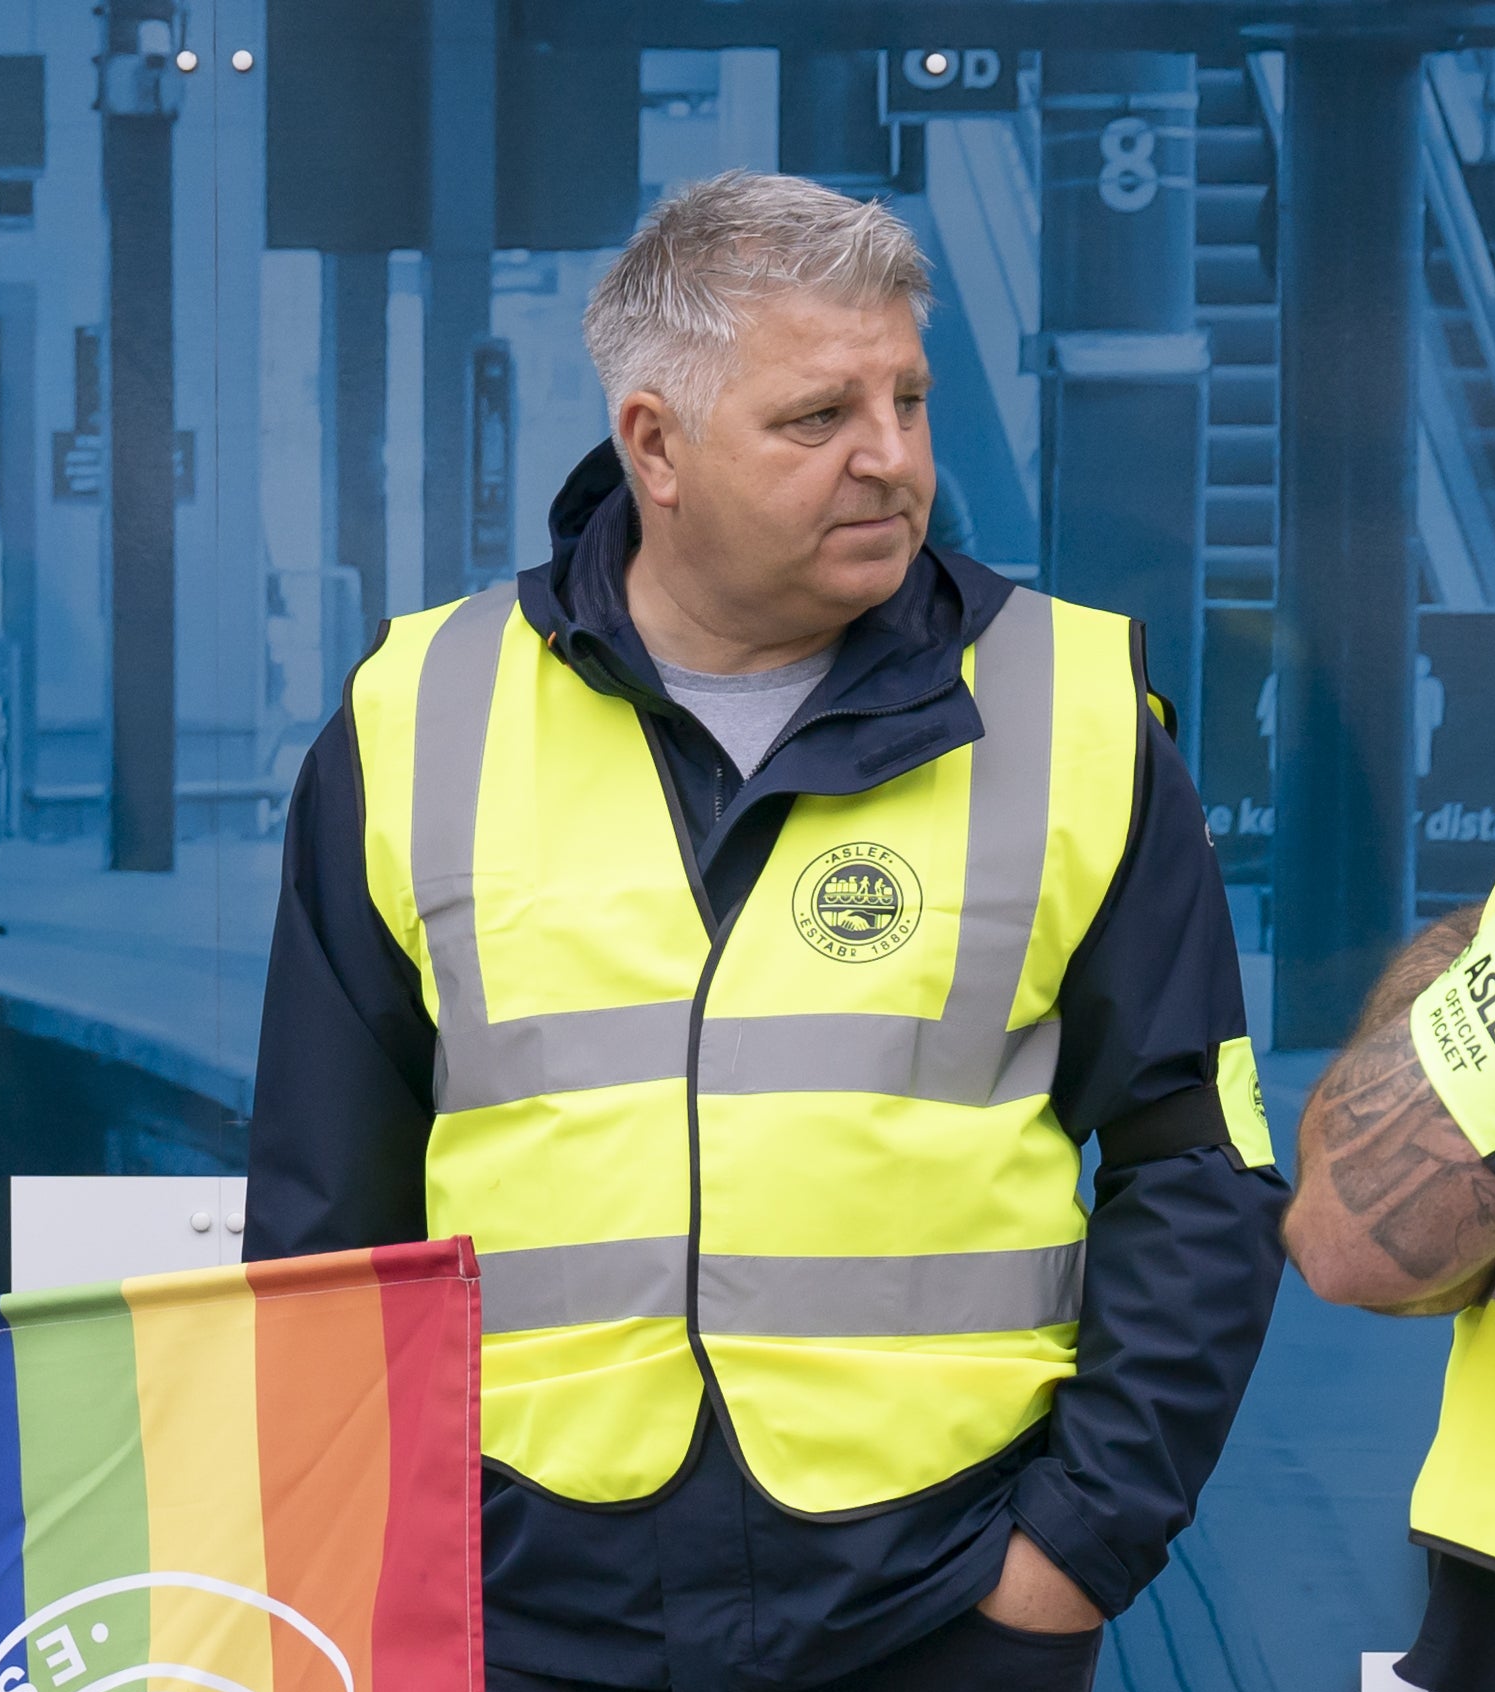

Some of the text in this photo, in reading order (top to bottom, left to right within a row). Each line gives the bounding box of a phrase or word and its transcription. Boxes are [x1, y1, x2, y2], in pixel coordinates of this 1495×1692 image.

[1099, 116, 1157, 213] 8
[830, 846, 891, 863] ASLEF
[870, 925, 910, 954] 1880
[1429, 1007, 1468, 1072] PICKET
[1445, 988, 1488, 1072] OFFICIAL
